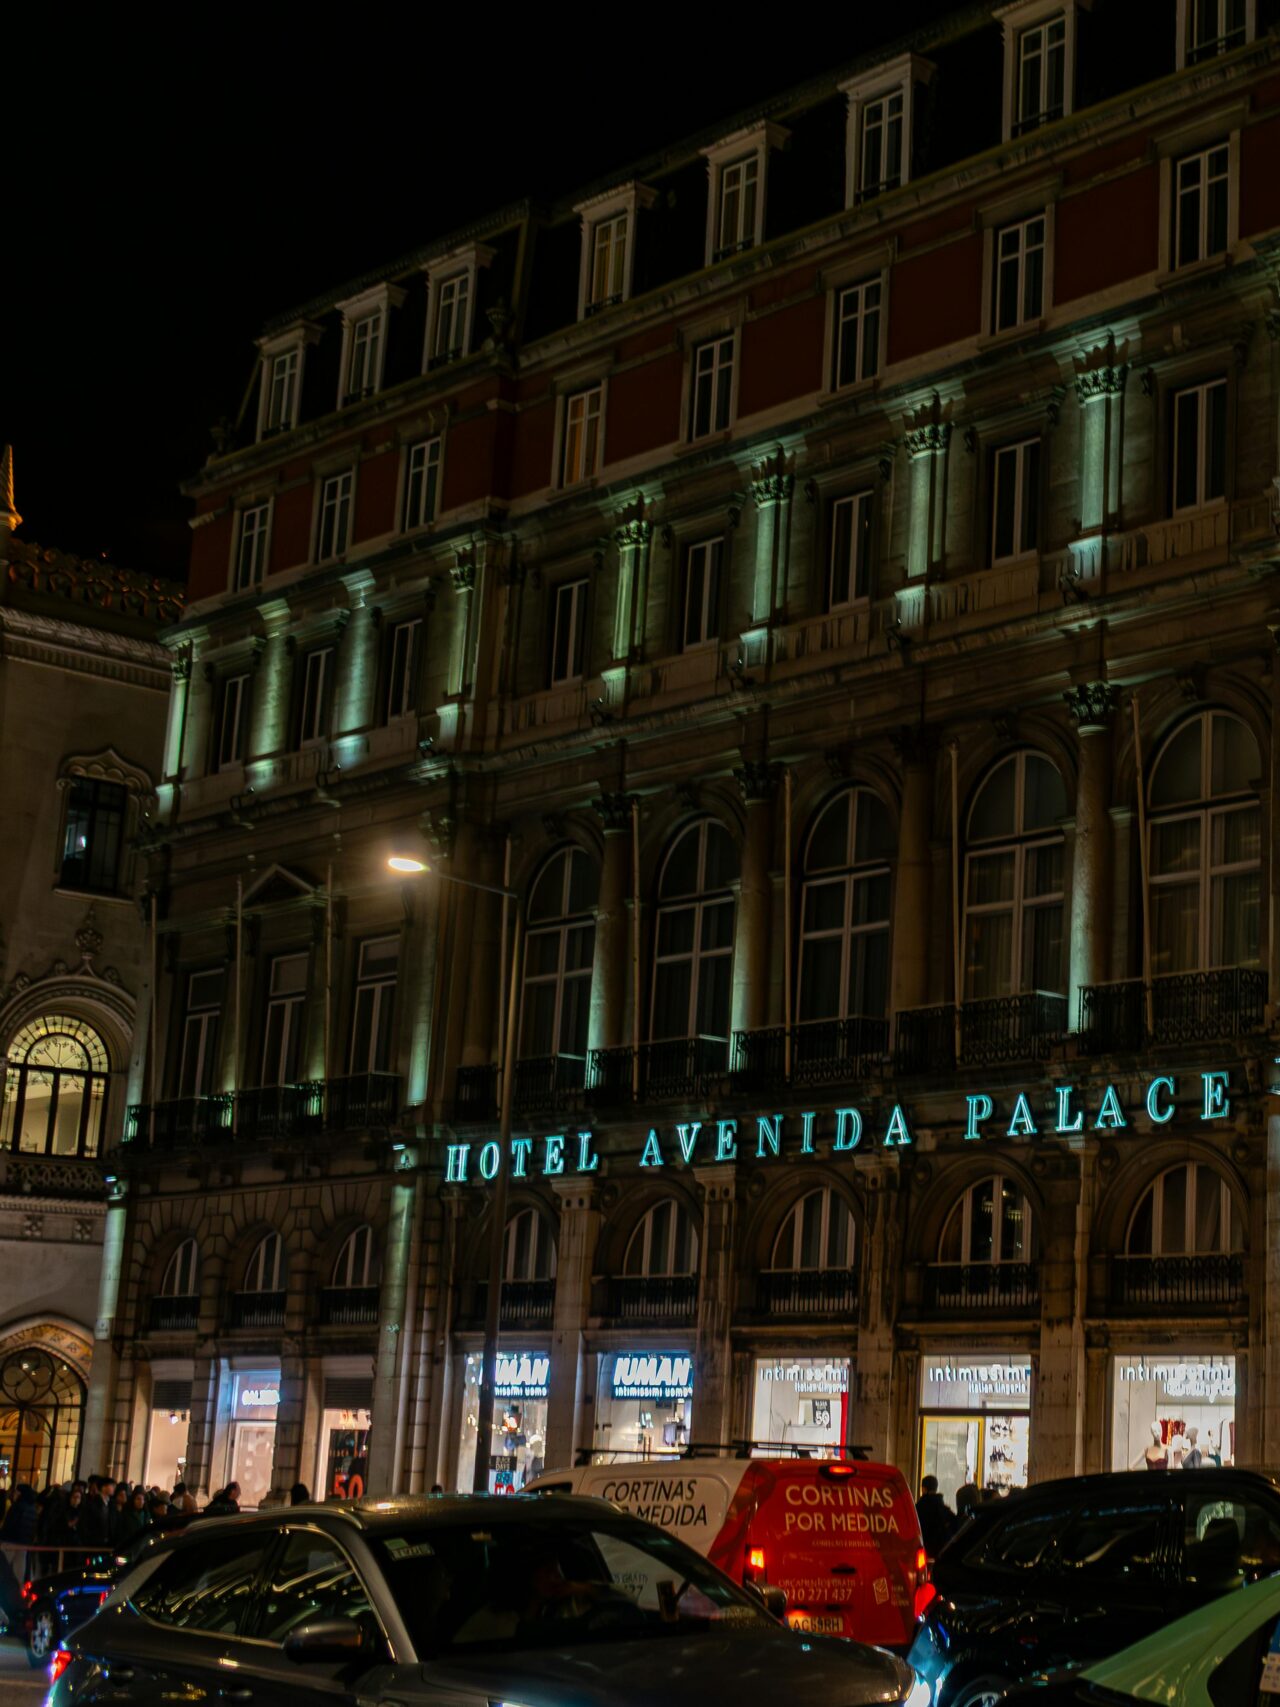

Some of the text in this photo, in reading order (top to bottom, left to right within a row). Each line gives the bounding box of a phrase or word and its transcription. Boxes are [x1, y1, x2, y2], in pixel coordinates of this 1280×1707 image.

[445, 1071, 1230, 1182] HOTEL AVENIDA PALACE
[760, 1365, 847, 1381] intimissimi
[929, 1364, 1027, 1382] intimissimi
[602, 1479, 697, 1502] CORTINAS
[785, 1485, 893, 1508] CORTINAS
[636, 1503, 708, 1526] MEDIDA
[785, 1512, 899, 1533] POR MEDIDA
[831, 1588, 852, 1601] 437
